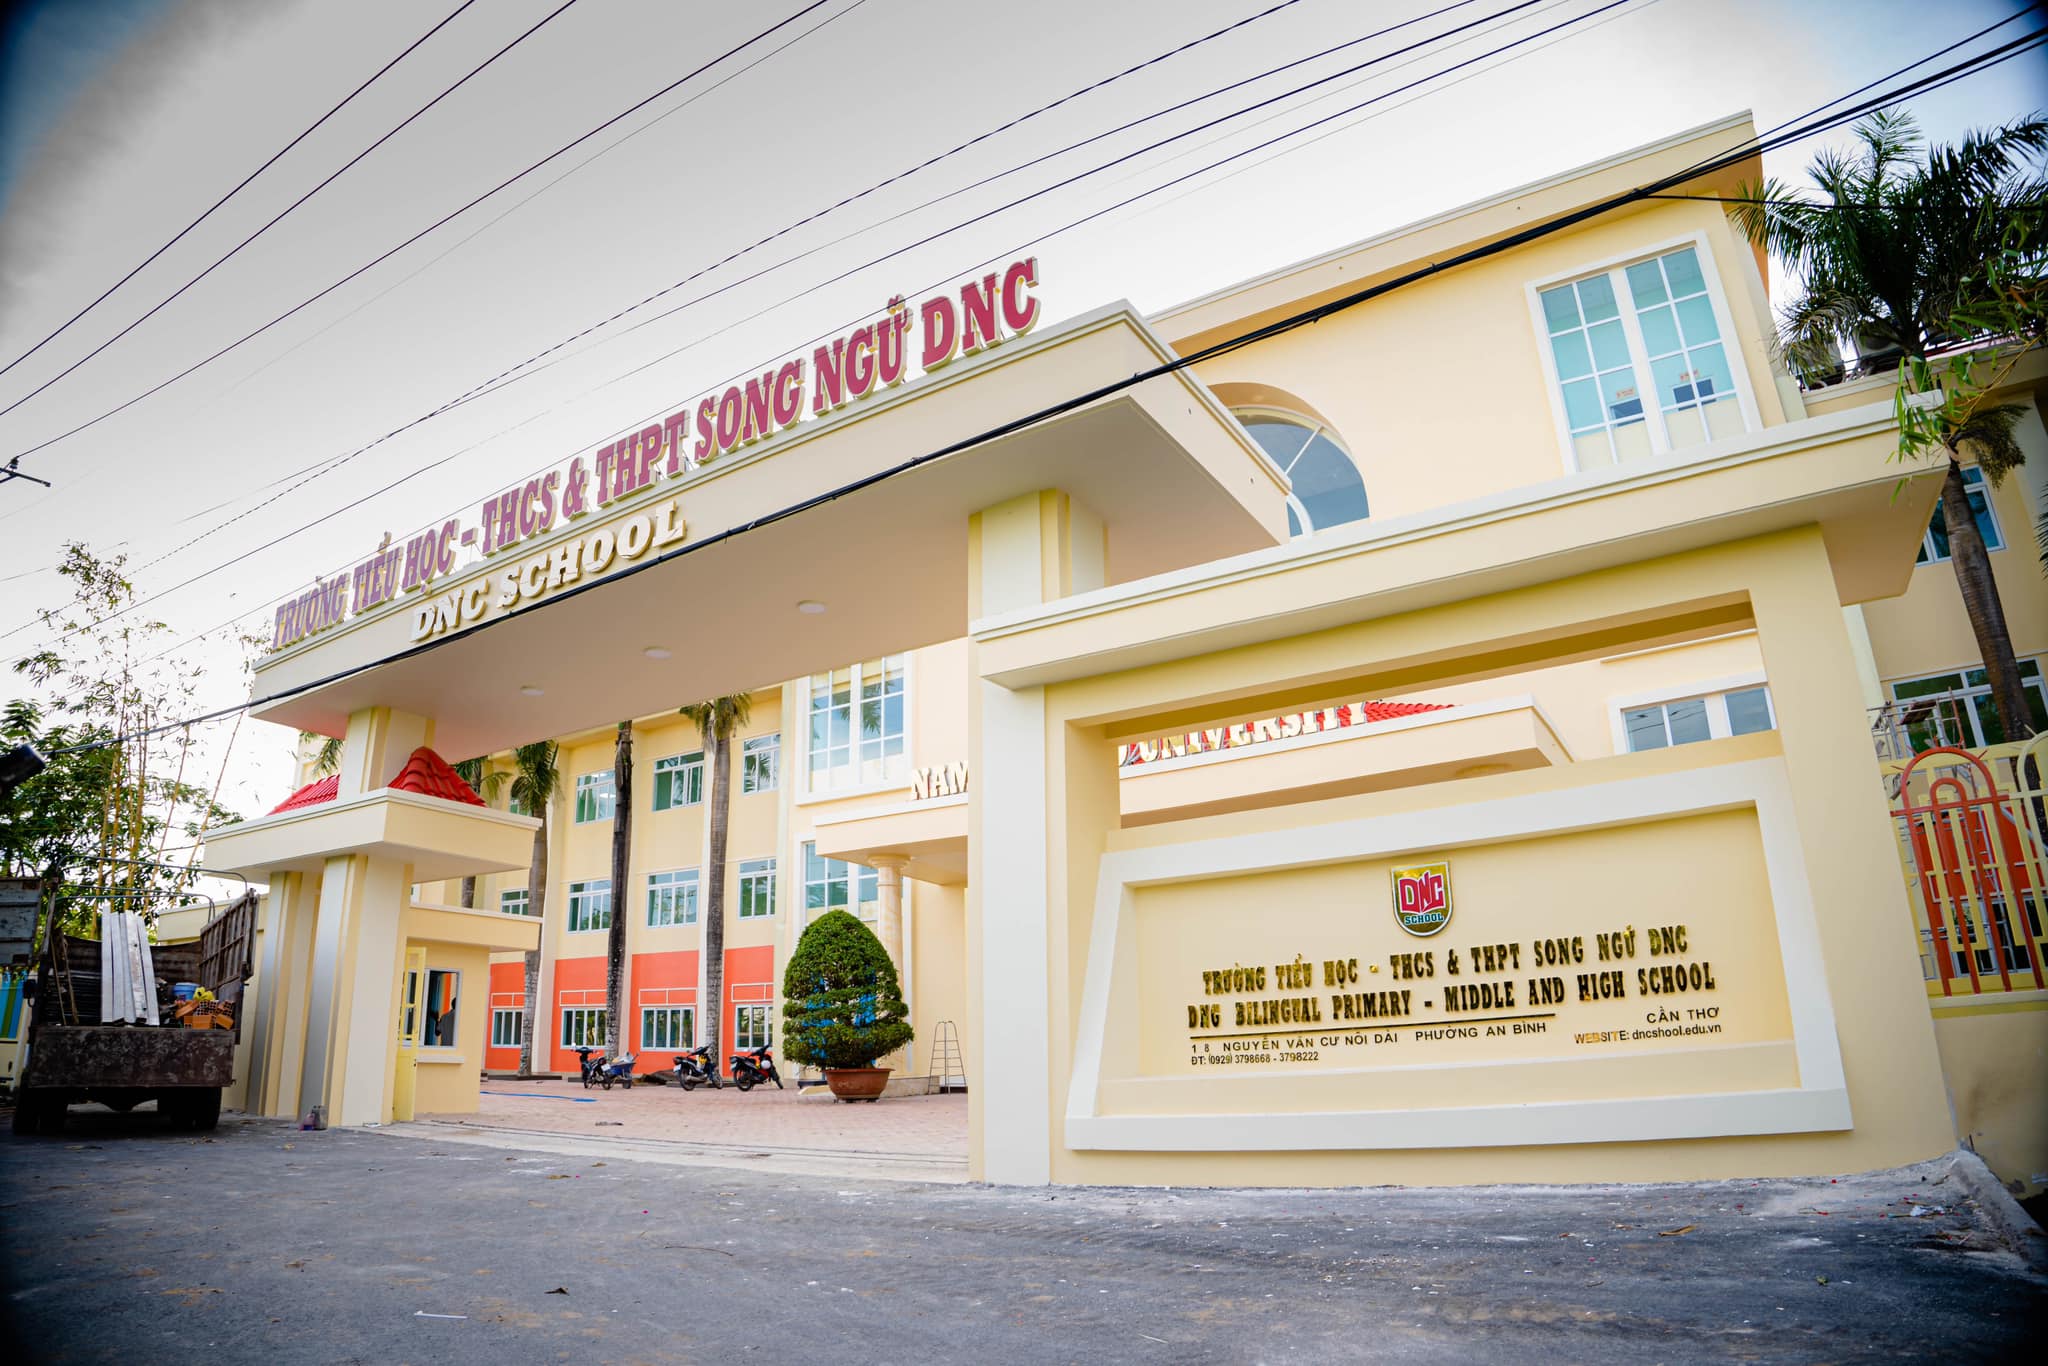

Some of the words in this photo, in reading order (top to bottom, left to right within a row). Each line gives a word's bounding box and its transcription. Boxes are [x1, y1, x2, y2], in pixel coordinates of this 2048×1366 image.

[352, 531, 403, 615] TIỂU
[402, 518, 460, 595] HỌC
[482, 470, 561, 557] THCS
[562, 457, 590, 521] &
[596, 409, 691, 508] THPT
[694, 357, 806, 464] SONG
[813, 294, 914, 416] NGỮ
[922, 257, 1041, 373] DNC
[408, 579, 490, 643] DNC
[496, 500, 688, 608] SCHOOL
[911, 760, 968, 800] NAM
[1398, 870, 1446, 914] DNC
[1405, 912, 1444, 925] SCHOOL
[1203, 962, 1266, 995] TRƯỜNG
[1275, 953, 1313, 990] TIỂU
[1323, 958, 1358, 990] HỌC
[1390, 951, 1434, 980] THCS
[1447, 949, 1459, 975] &
[1470, 943, 1520, 973] THPT
[1534, 936, 1584, 967] SONG
[1648, 924, 1688, 956] DNC
[1235, 997, 1321, 1026] BILINGUAL
[1332, 990, 1411, 1020] PRIMARY
[1444, 981, 1515, 1012] MIDDLE
[1528, 977, 1565, 1005] AND
[1577, 970, 1625, 1001] HIGH
[1637, 962, 1715, 996] SCHOOL
[1646, 1005, 1680, 1024] CẦN
[1687, 1007, 1720, 1020] THƠ
[1415, 1025, 1478, 1042] PHƯỜNG
[1486, 1025, 1506, 1037] AN
[1513, 1020, 1547, 1034] BÌNH
[1574, 1030, 1630, 1044] WEBSITE:
